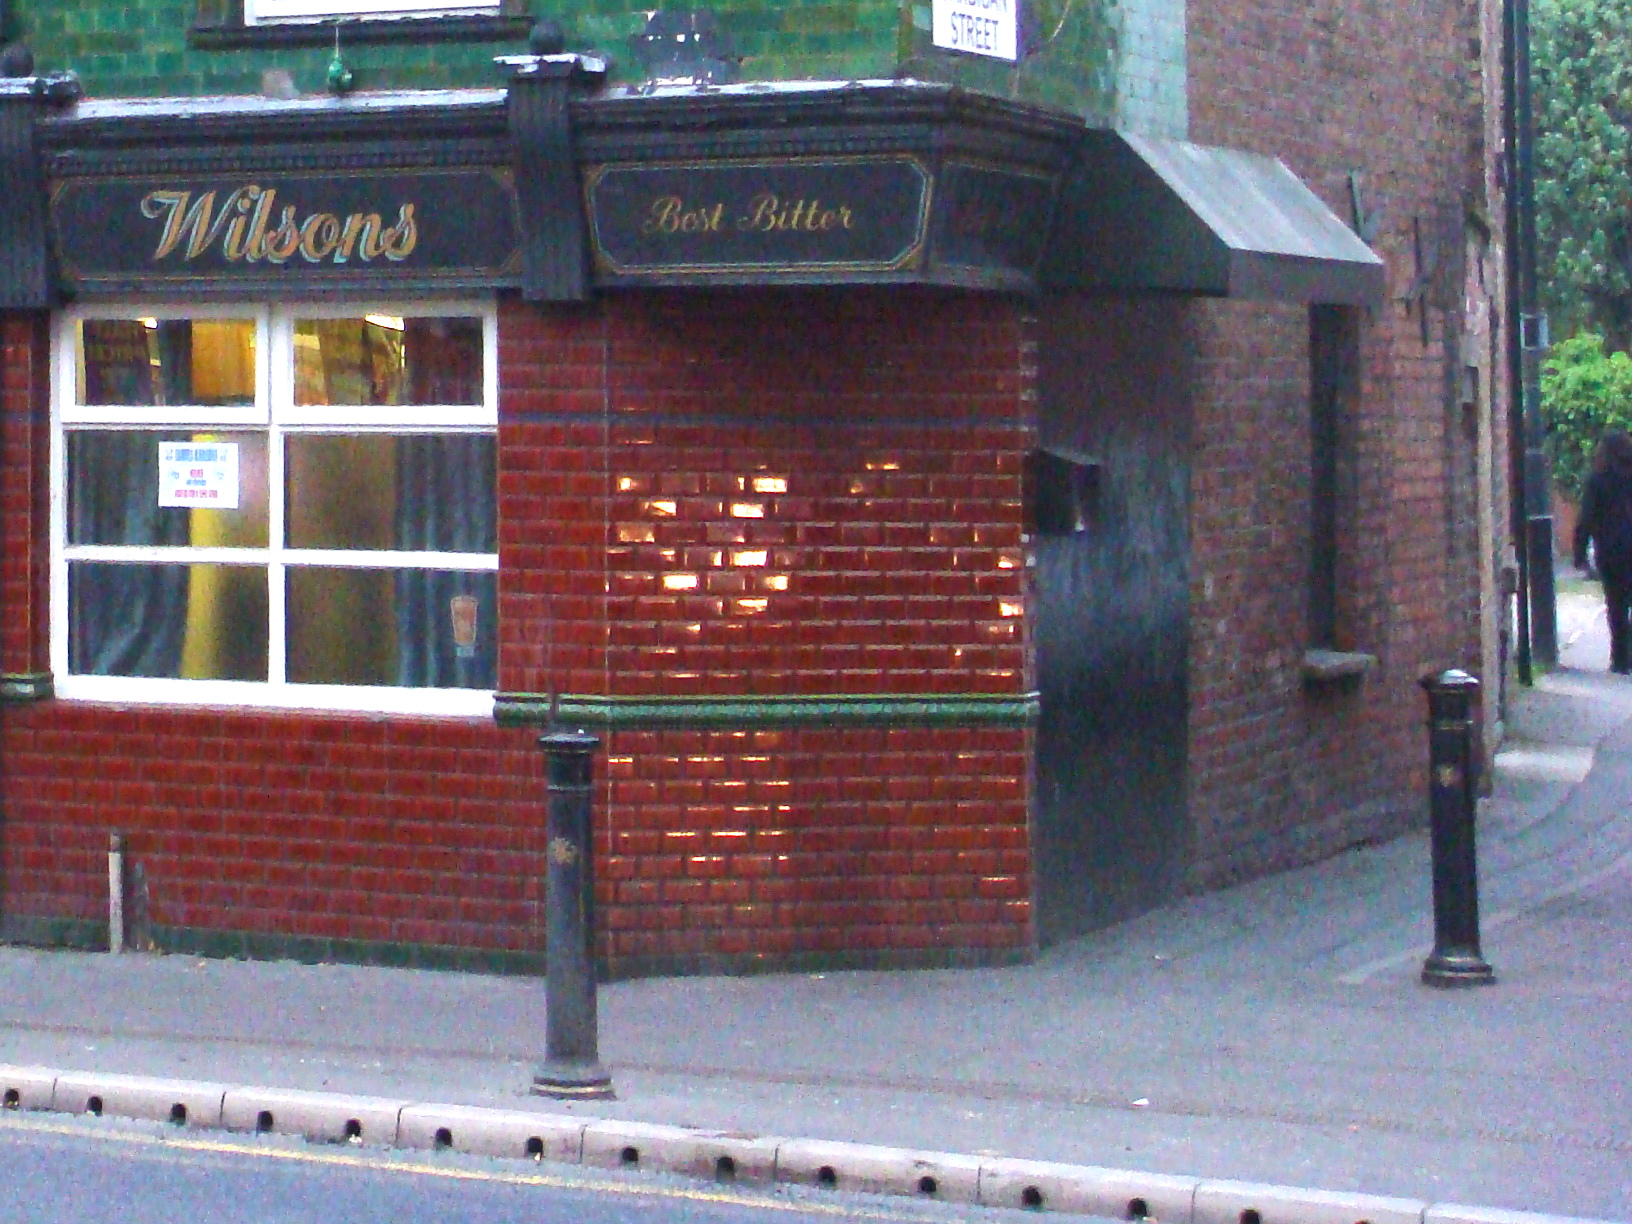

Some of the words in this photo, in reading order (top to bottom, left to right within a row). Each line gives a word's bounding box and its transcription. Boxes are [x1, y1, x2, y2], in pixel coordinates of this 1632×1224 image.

[950, 10, 999, 52] STREET
[140, 184, 418, 264] Wilsons
[644, 196, 724, 233] Best
[738, 194, 857, 232] Bitter
